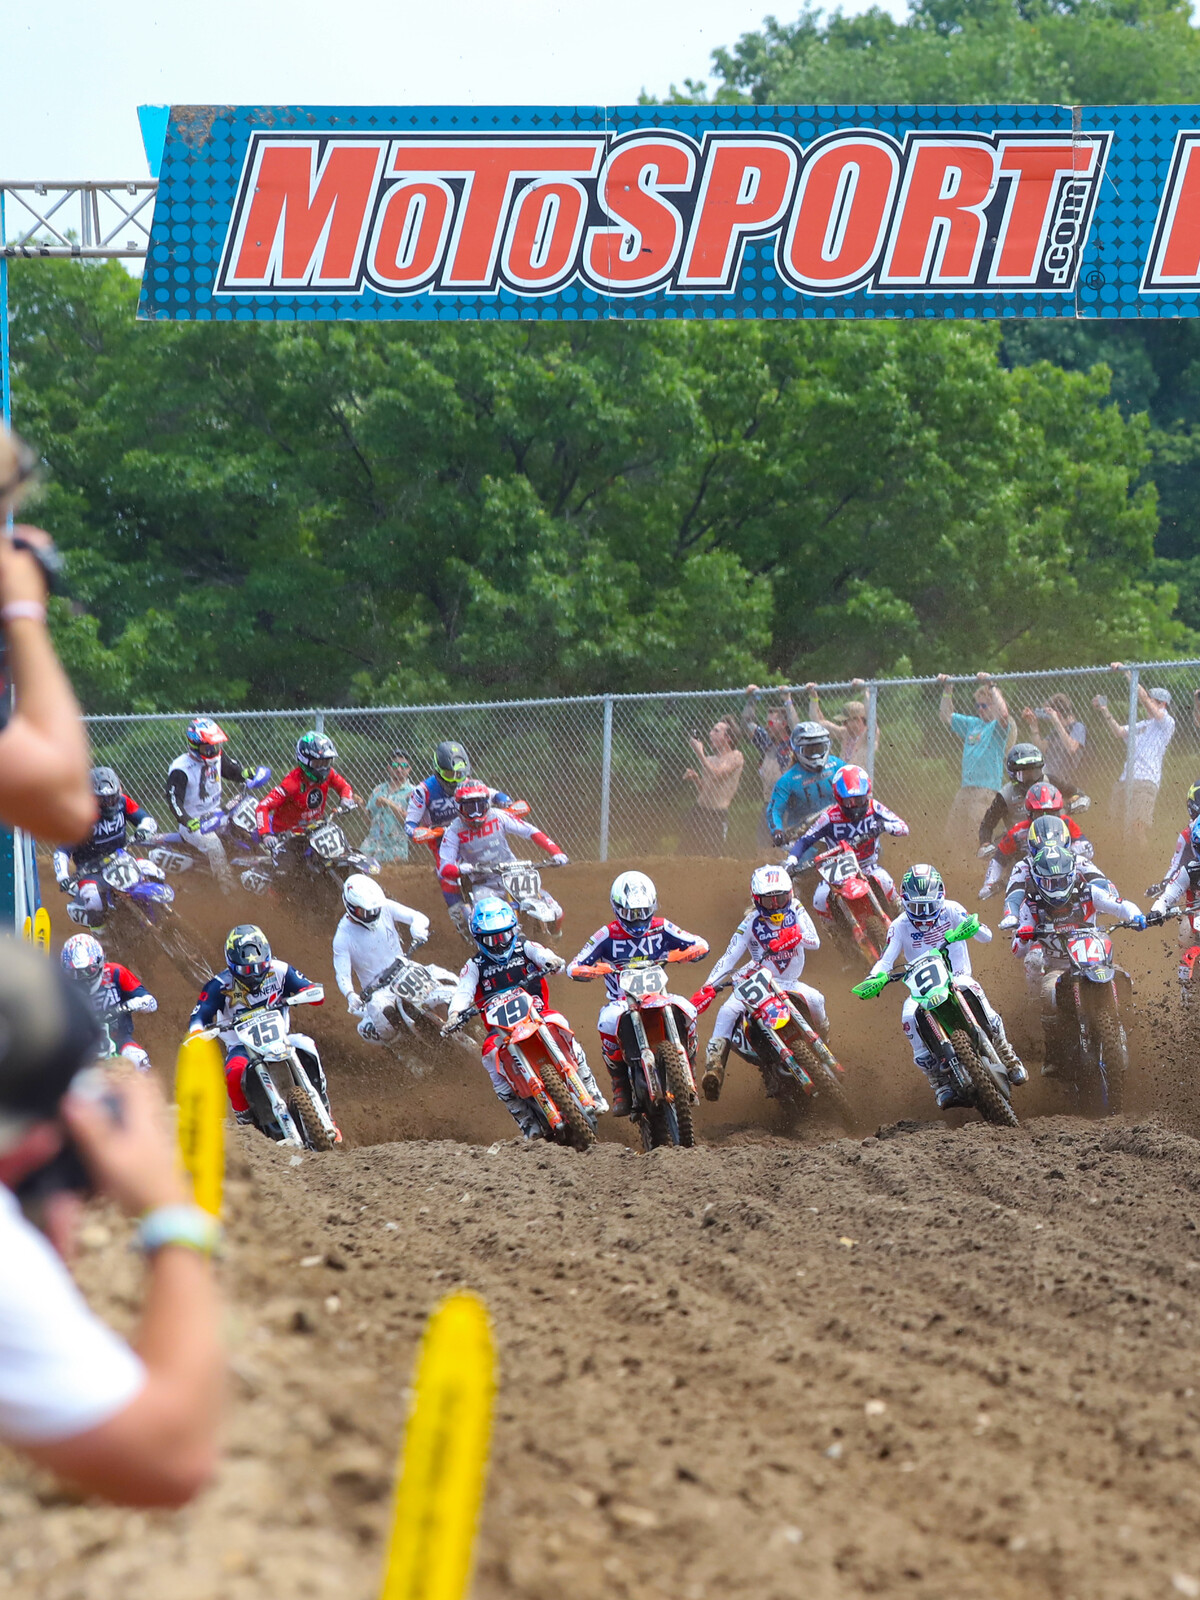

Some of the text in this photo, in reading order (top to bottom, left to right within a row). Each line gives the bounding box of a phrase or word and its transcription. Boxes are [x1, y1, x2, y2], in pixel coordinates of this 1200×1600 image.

[458, 818, 500, 844] SHOT
[824, 856, 858, 884] 72
[510, 875, 540, 899] 441
[954, 924, 976, 940] ACERBIS
[612, 933, 664, 958] FXR
[1070, 938, 1103, 962] 14
[628, 972, 663, 995] 43
[738, 972, 771, 1004] 51
[914, 964, 942, 996] 9
[491, 994, 529, 1028] 19
[247, 1018, 281, 1047] 15
